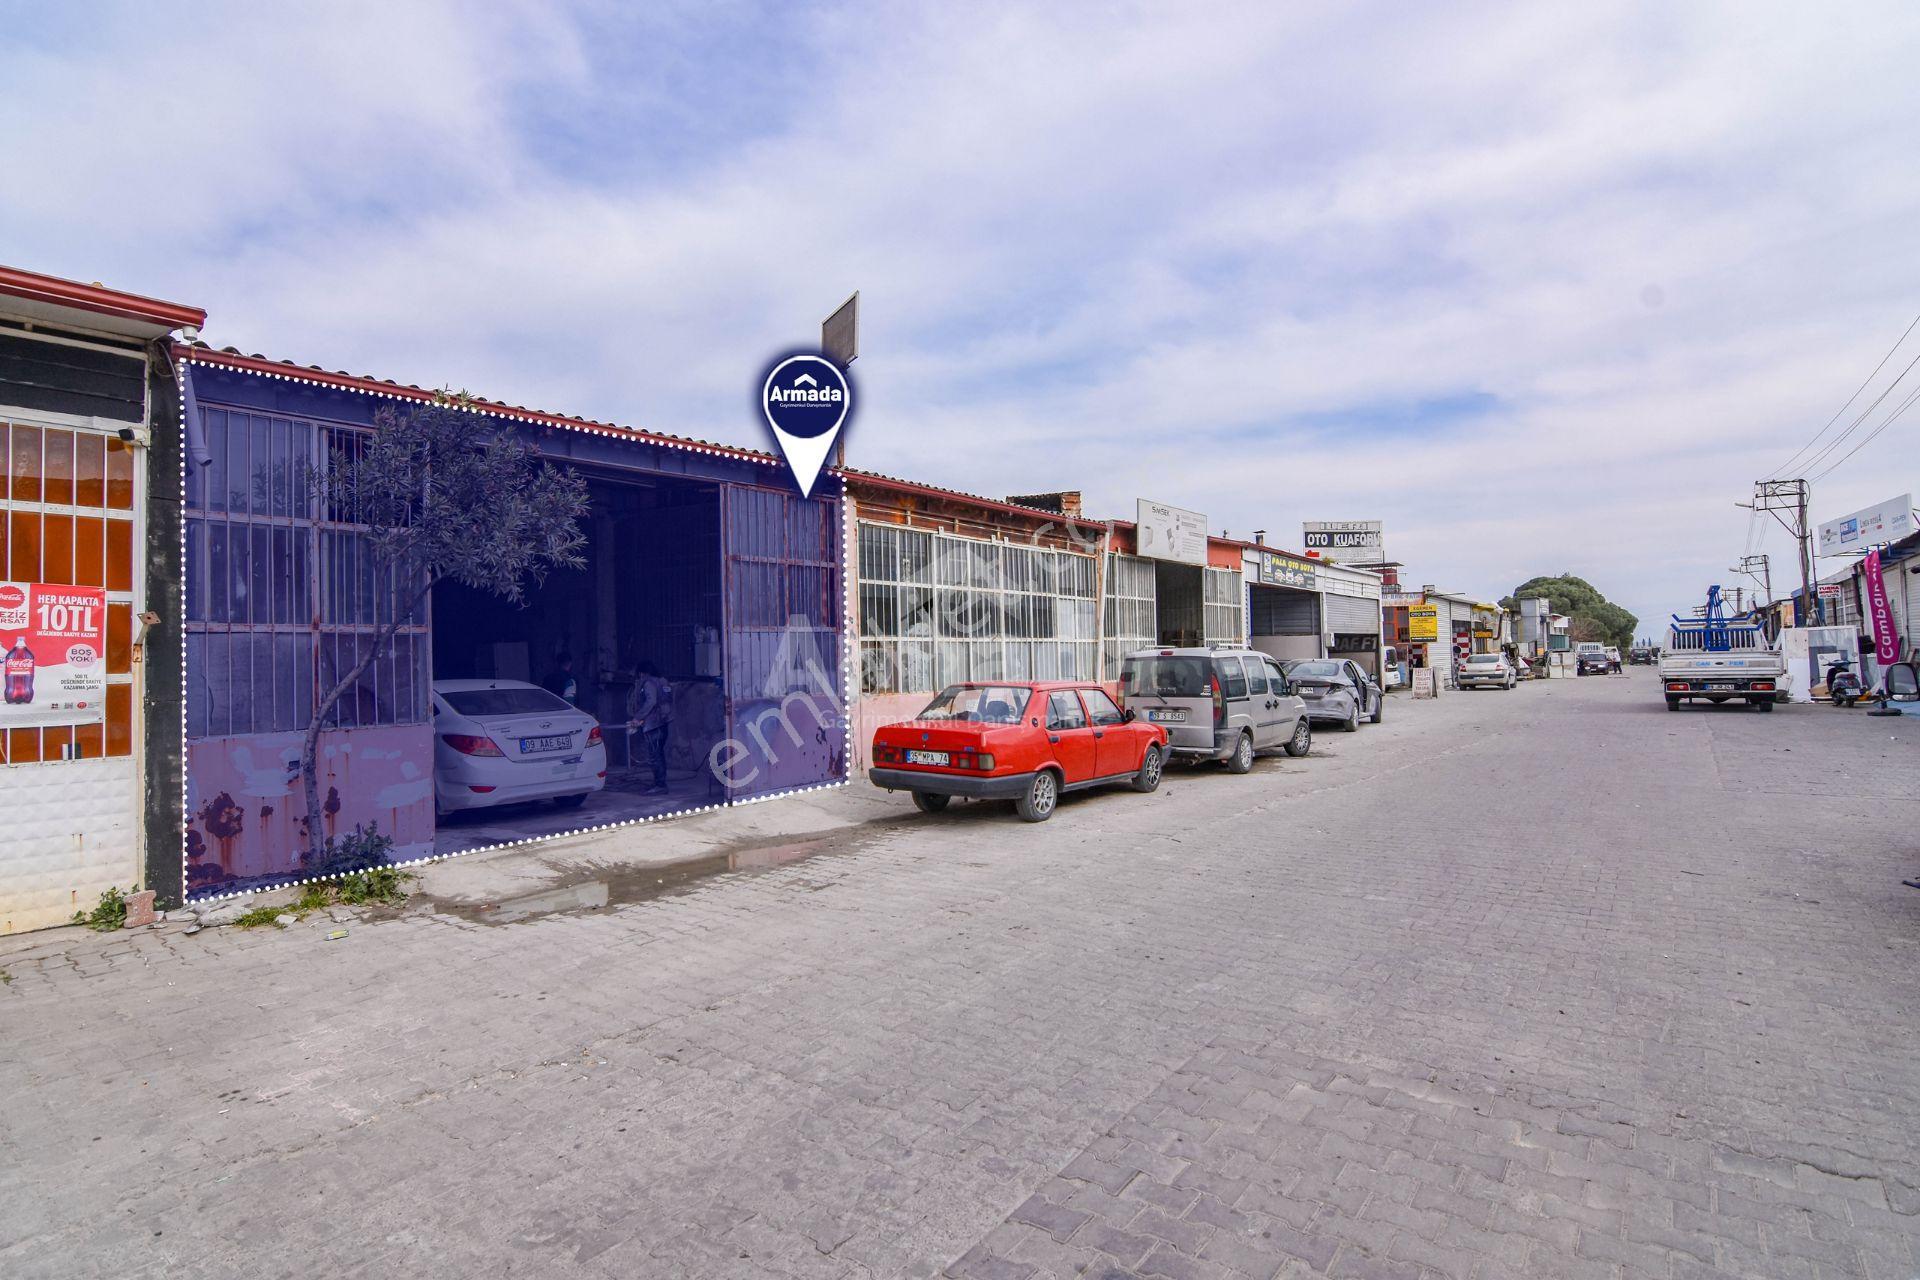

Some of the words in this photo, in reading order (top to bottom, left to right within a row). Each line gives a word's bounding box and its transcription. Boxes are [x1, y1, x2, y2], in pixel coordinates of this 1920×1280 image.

[1307, 533, 1329, 546] OTO
[1271, 556, 1287, 567] PALA
[1287, 560, 1299, 570] OTO
[38, 594, 57, 604] HER
[58, 595, 99, 606] KAPAKTA
[0, 610, 27, 619] EZİZ
[37, 604, 99, 632] 10TL
[69, 655, 93, 663] YOK!
[526, 740, 535, 749] 09
[540, 738, 554, 748] AAE
[556, 738, 570, 747] 649
[909, 752, 918, 761] 35
[922, 753, 935, 762] MPA
[939, 753, 948, 761] 74
